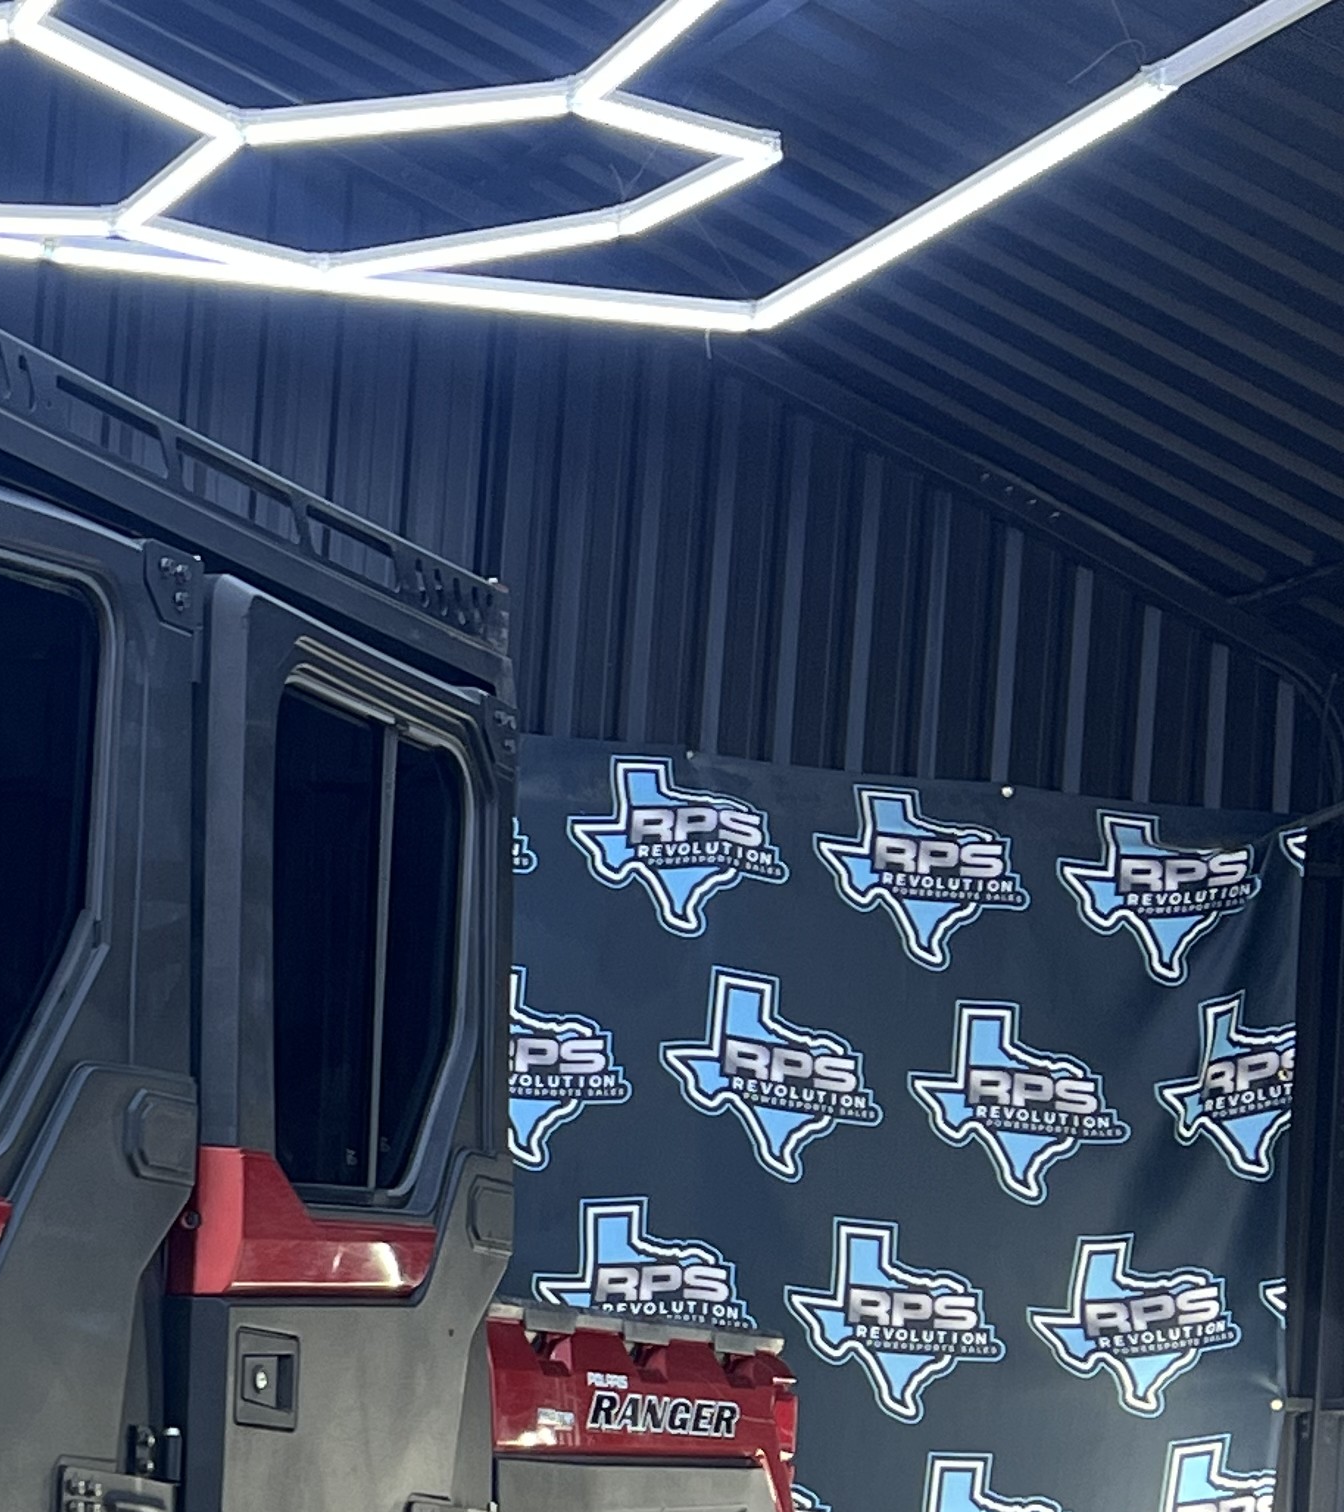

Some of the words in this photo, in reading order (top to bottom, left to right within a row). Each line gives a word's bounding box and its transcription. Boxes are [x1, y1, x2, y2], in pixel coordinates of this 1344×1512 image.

[631, 808, 763, 847] RPS
[638, 841, 772, 866] REVOLUTION
[874, 836, 1003, 878] RPS
[1119, 851, 1248, 892] RPS
[882, 872, 1012, 892] REVOLUTION
[1127, 884, 1251, 906] REVOLUTION
[509, 1038, 605, 1074] PS
[724, 1039, 856, 1093] RPS
[509, 1074, 615, 1088] VOLUTION
[732, 1077, 865, 1108] REVOLUTION
[968, 1070, 1099, 1113] RPS
[1205, 1085, 1293, 1112] REVOLUT
[976, 1105, 1109, 1128] REVOLUTION
[593, 1265, 729, 1302] RPS
[848, 1289, 977, 1330] RPS
[1086, 1287, 1220, 1337] RPS
[856, 1325, 987, 1344] REVOLUTION
[1099, 1320, 1227, 1348] REVOLUTION
[586, 1390, 740, 1438] RANGER
